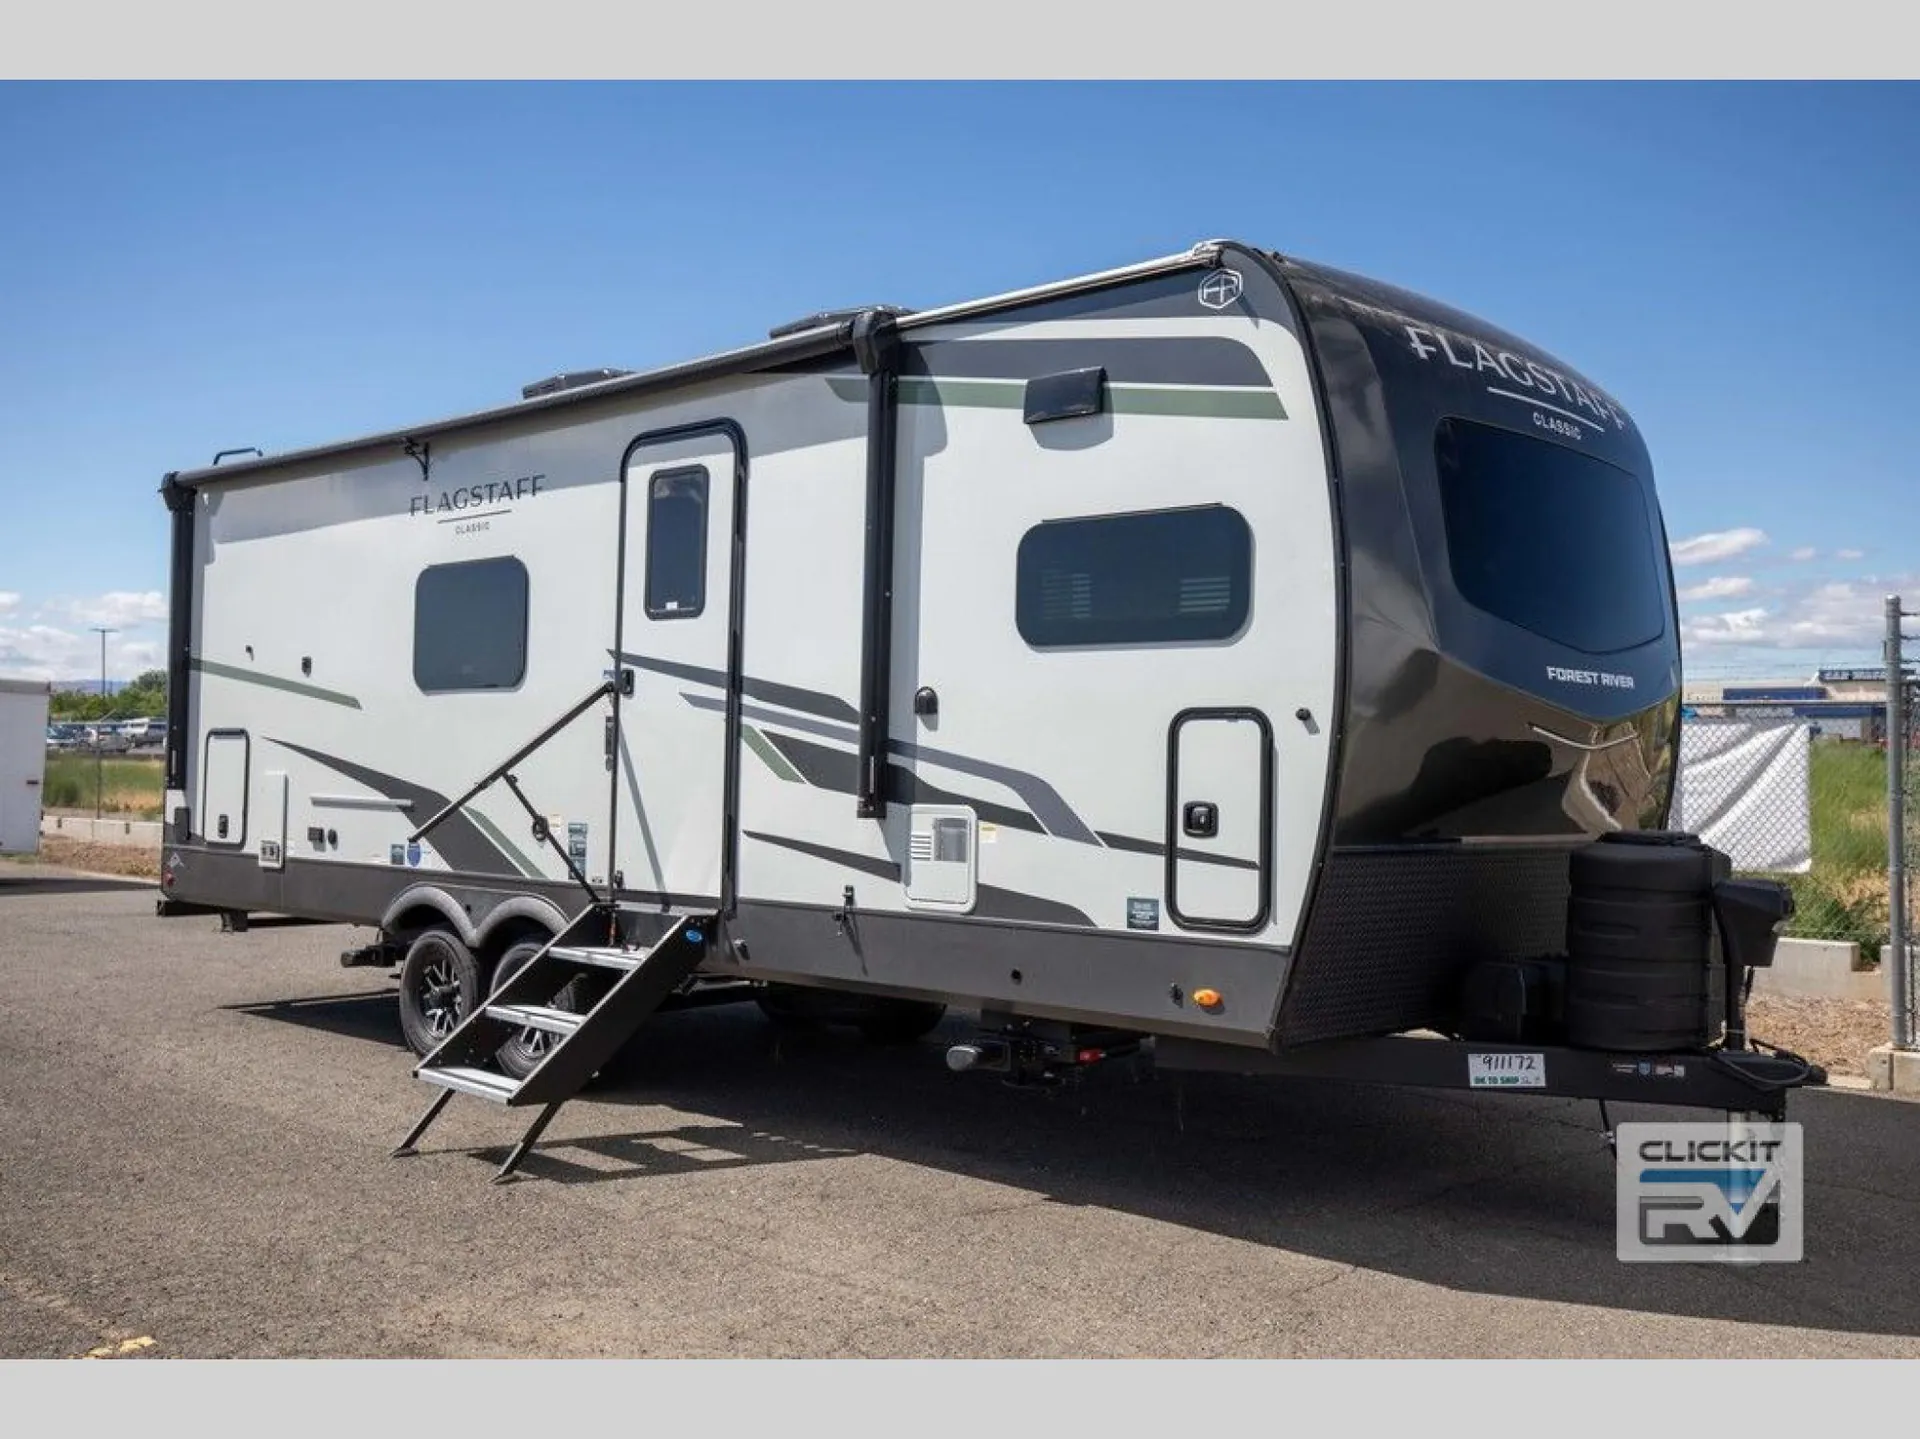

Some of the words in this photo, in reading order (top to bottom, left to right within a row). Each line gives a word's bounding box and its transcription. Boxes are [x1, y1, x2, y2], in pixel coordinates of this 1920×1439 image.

[1533, 411, 1582, 440] CLASSIC
[410, 474, 546, 516] FLAGSTAFF
[455, 521, 490, 535] CLASSIC
[1546, 665, 1598, 685] FOREST
[1600, 673, 1635, 689] RIVER
